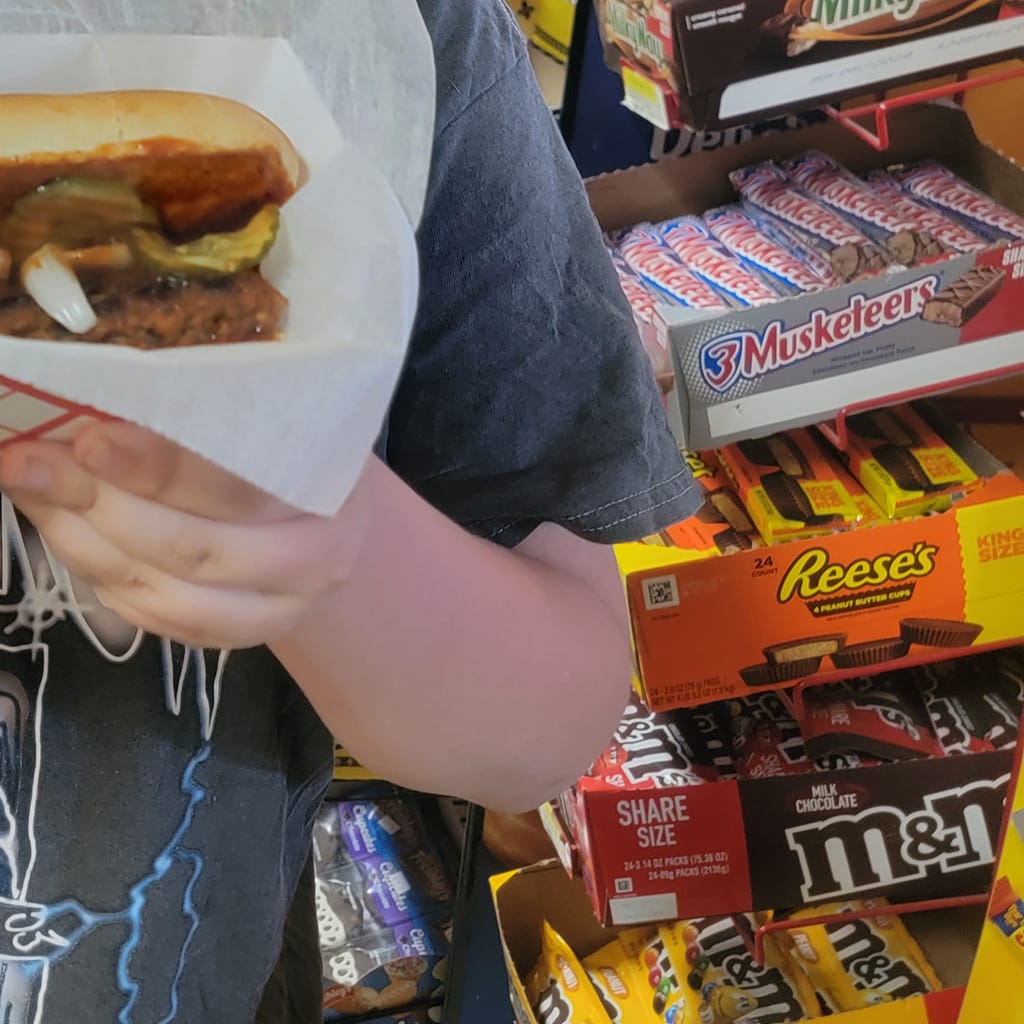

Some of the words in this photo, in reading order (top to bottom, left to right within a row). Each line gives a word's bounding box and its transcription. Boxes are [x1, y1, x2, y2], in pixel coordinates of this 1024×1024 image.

[707, 343, 737, 388] 3
[742, 278, 937, 376] Musketeers
[977, 528, 1024, 549] KING
[755, 556, 773, 569] 24
[979, 542, 1024, 563] SIZE
[779, 542, 936, 602] Reese's
[820, 600, 854, 613] PEANUT
[854, 594, 887, 607] BUTTER
[888, 589, 911, 601] CUPS
[812, 784, 838, 798] MILK
[616, 795, 690, 826] SHARE
[796, 793, 858, 814] CHOCOLATE
[637, 824, 678, 848] SIZE
[653, 859, 663, 868] OZ
[665, 857, 689, 867] PACKS
[675, 866, 699, 878] PACKS
